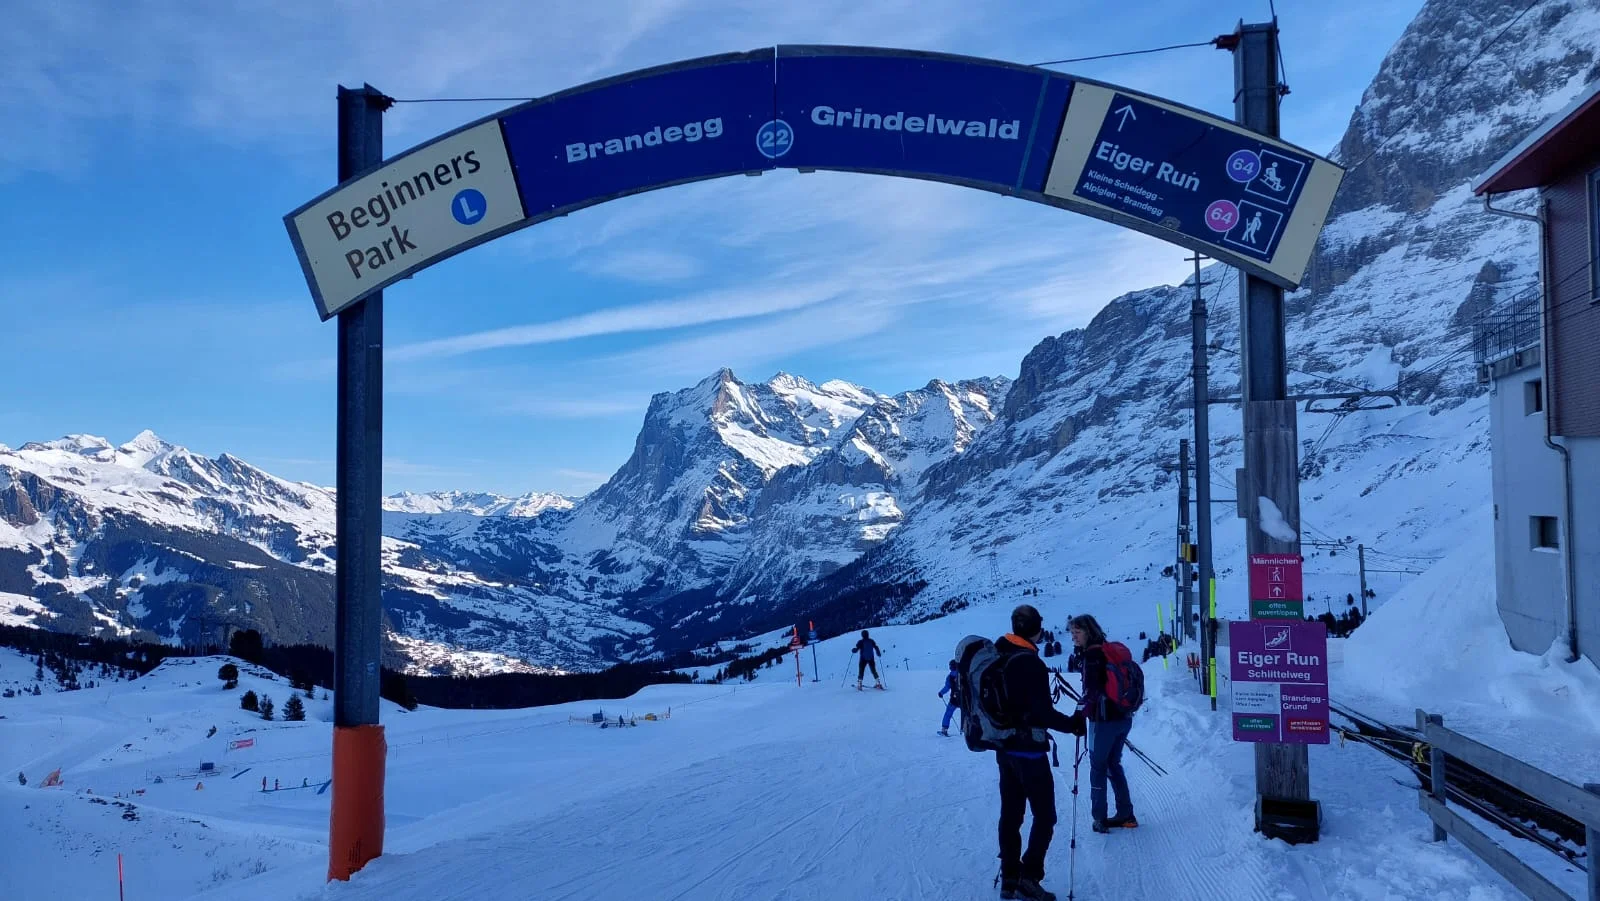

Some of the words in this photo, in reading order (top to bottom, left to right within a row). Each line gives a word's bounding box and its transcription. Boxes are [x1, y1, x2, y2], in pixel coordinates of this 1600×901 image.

[811, 105, 1019, 140] Grindelwald
[565, 117, 723, 163] Brandegg
[762, 129, 788, 148] 22
[1096, 141, 1154, 174] Eiger
[1156, 161, 1200, 192] Run
[1232, 158, 1254, 175] 64
[1088, 169, 1114, 184] Kleine
[1114, 179, 1158, 200] Scheidegg
[326, 150, 481, 241] Beginners
[1082, 182, 1117, 199] Alpiglen
[1123, 196, 1164, 216] Brandegg
[459, 197, 478, 219] L
[1211, 208, 1232, 225] 64
[345, 225, 417, 279] Park
[1253, 557, 1299, 565] Männlichen
[1238, 651, 1280, 668] Eiger
[1286, 652, 1319, 666] Run
[1248, 669, 1311, 681] Schlittelweg
[1282, 694, 1321, 704] Brandegg
[1282, 702, 1308, 710] Grund
